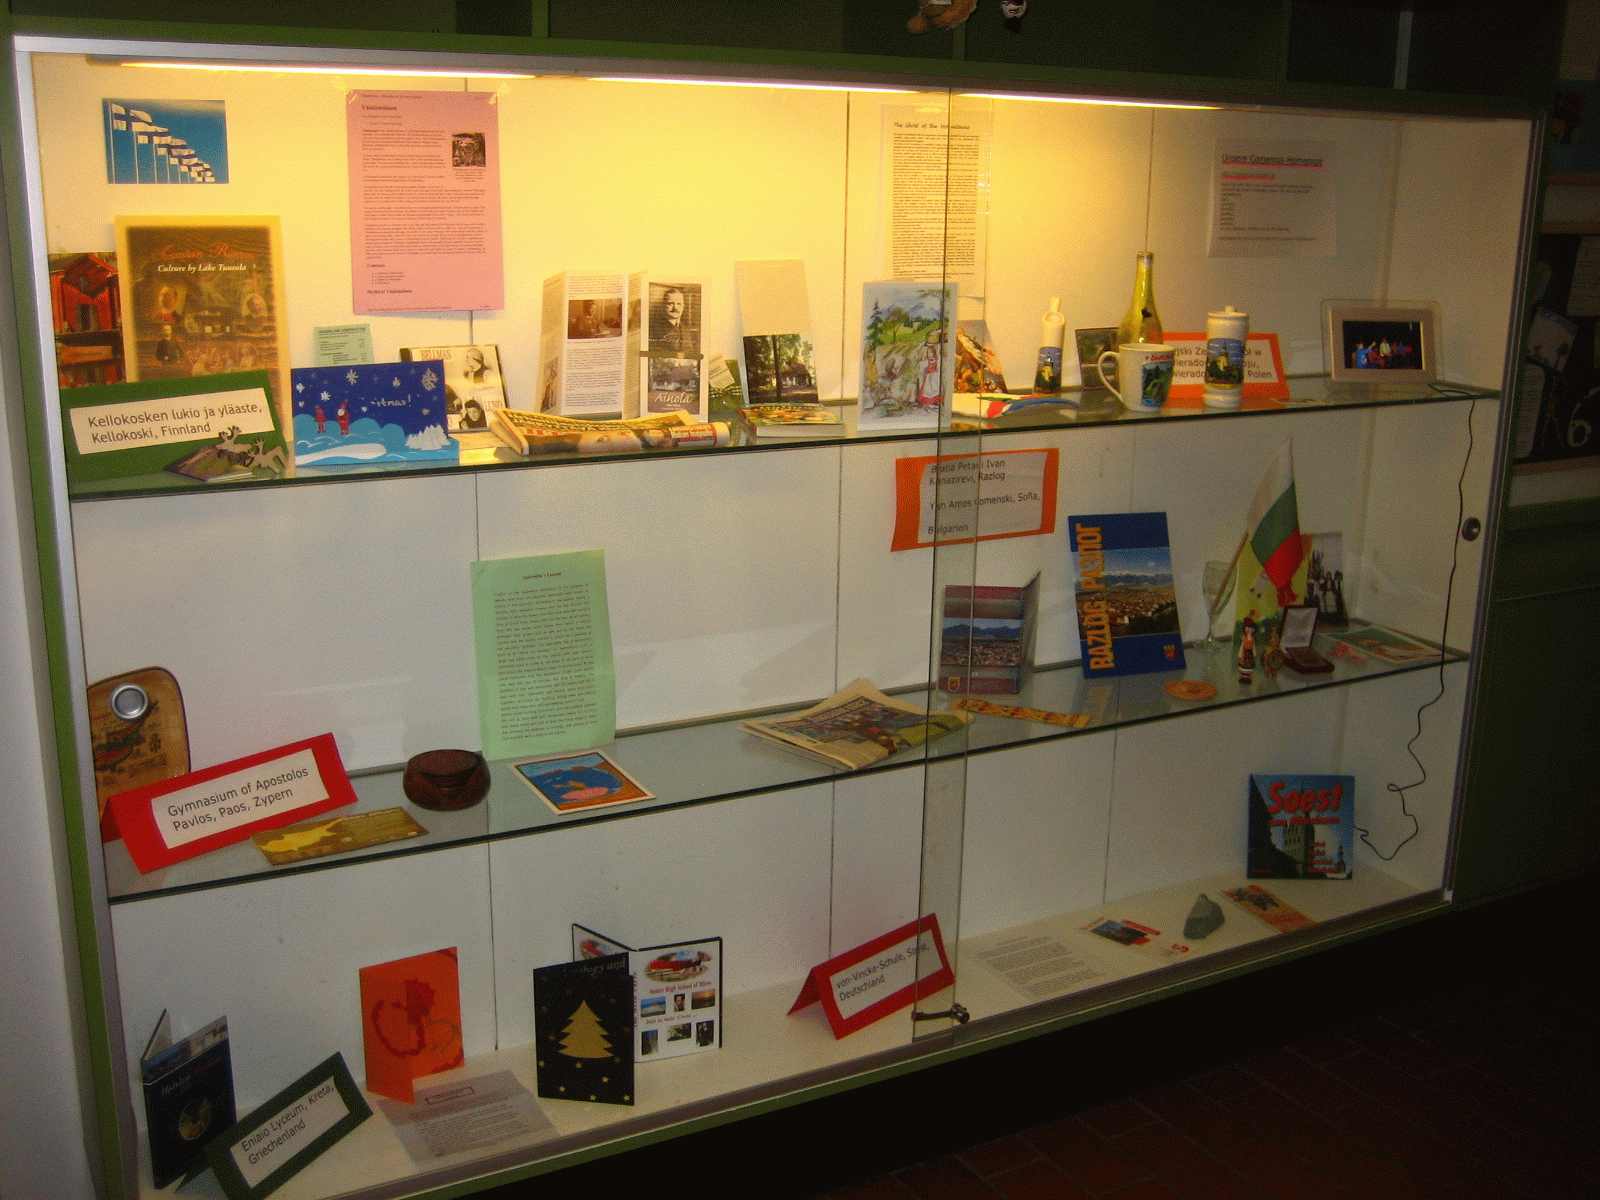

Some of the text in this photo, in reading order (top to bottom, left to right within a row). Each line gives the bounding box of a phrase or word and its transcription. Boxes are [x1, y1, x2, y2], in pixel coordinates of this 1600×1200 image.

[157, 264, 186, 272] Culture
[188, 264, 196, 274] by
[198, 264, 217, 272] Lake
[88, 402, 262, 428] Kellokosken lukio ja yläaste,
[92, 423, 212, 444] Kellokoski, Finnland
[986, 459, 1006, 469] Ivan
[167, 766, 310, 817] Gymnasium of Apostolos
[1266, 782, 1344, 814] Soest
[172, 787, 294, 832] Pavlos, Paos, Zypern
[839, 974, 886, 1001] Deutschland
[270, 1103, 309, 1133] Lyceum,
[308, 1085, 335, 1106] Kreta,
[248, 1120, 306, 1166] Griechenland
